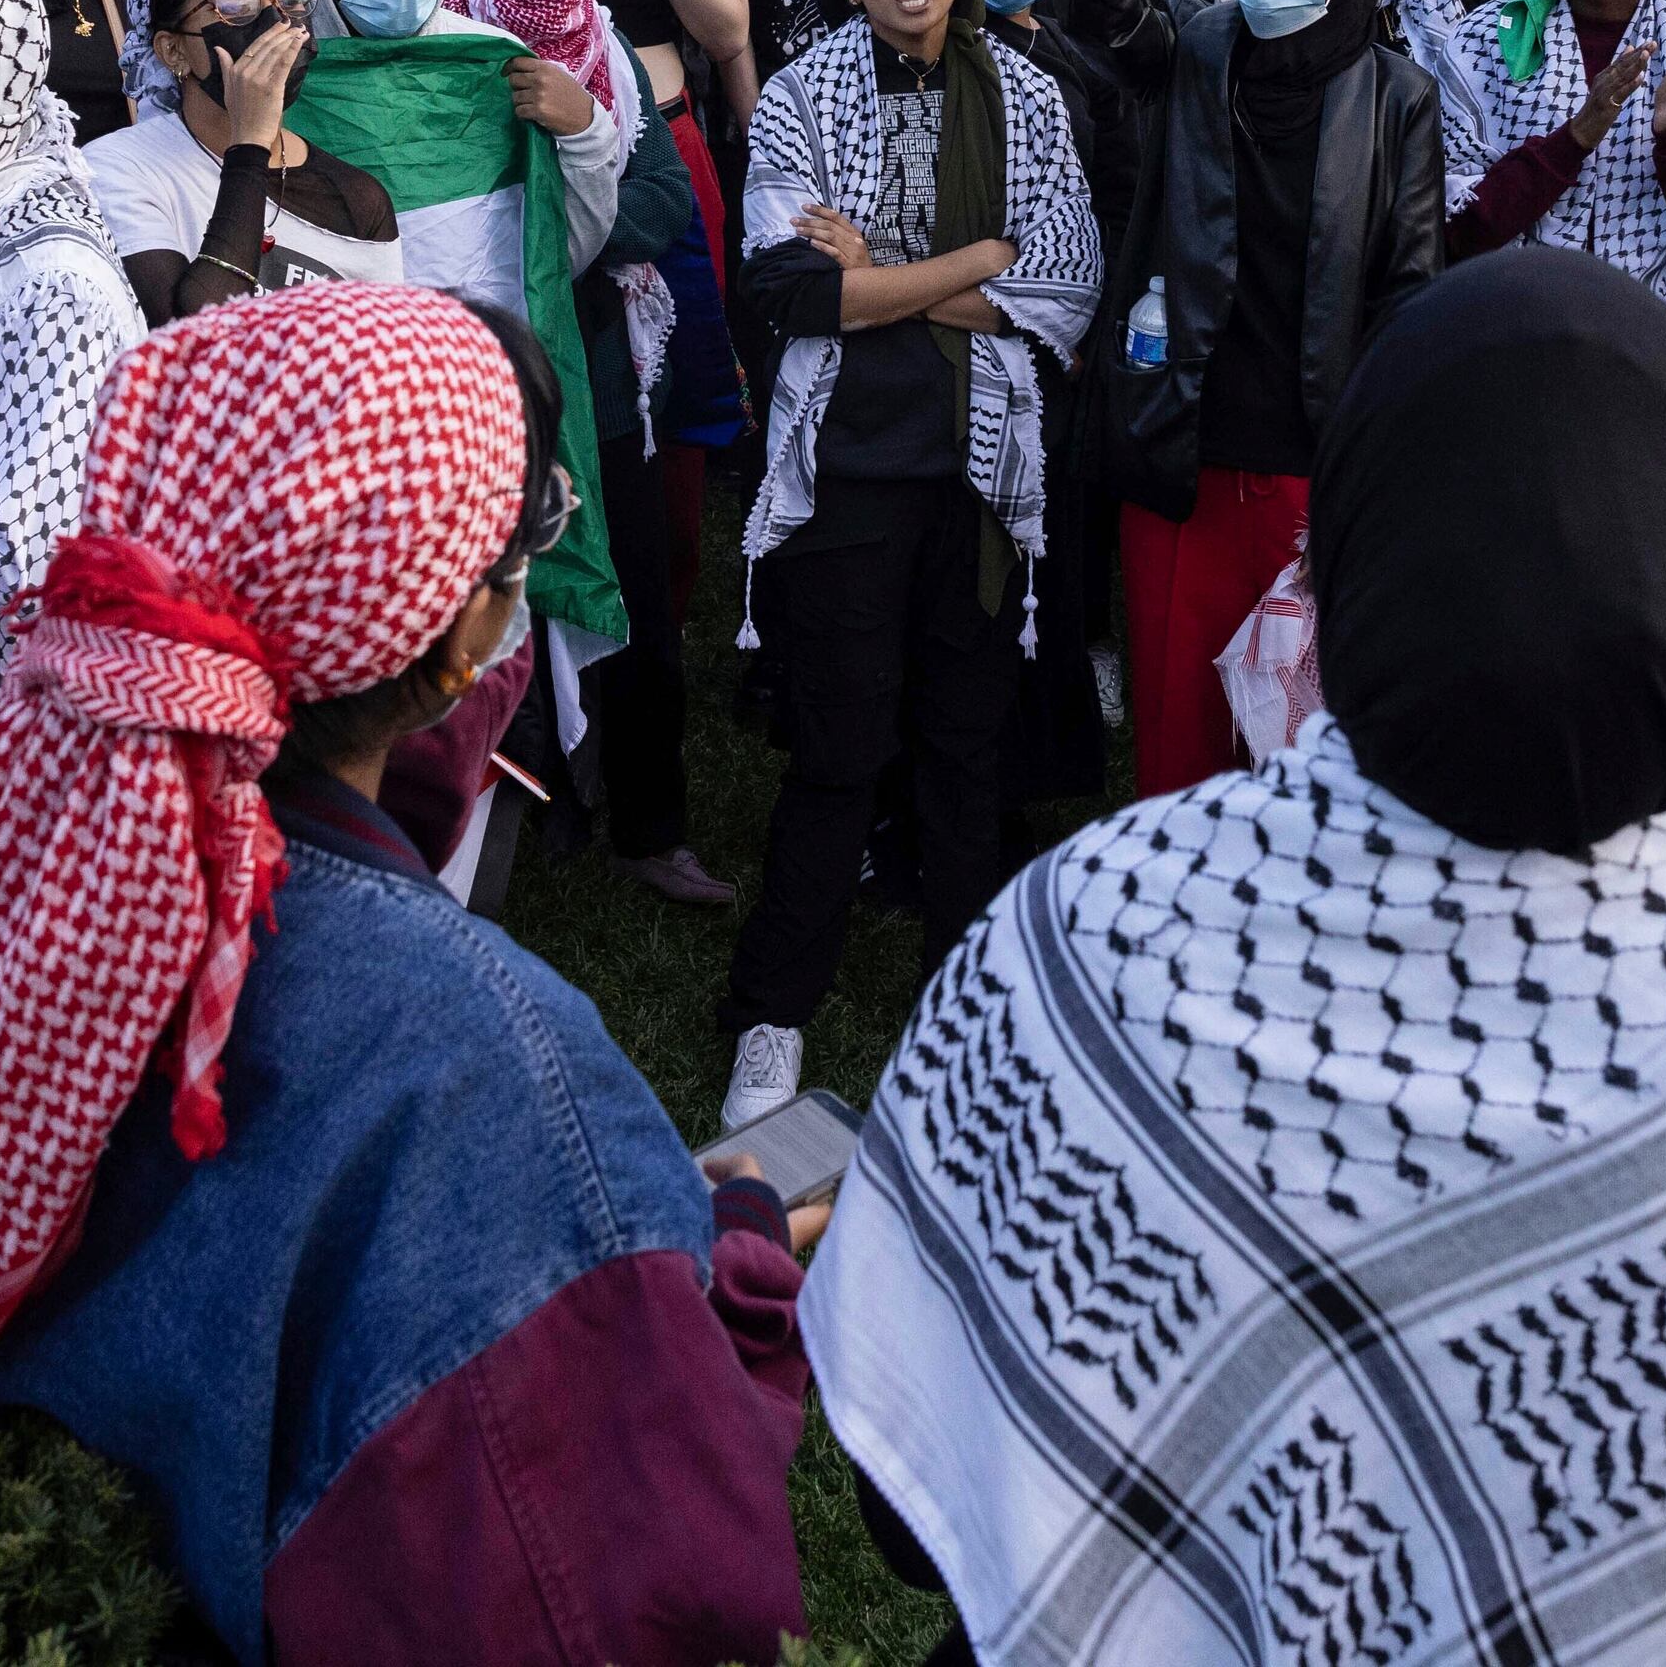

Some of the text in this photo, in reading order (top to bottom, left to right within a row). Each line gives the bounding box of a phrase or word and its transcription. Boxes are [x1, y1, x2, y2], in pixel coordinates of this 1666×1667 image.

[901, 153, 933, 163] SOMALIA
[904, 168, 933, 177] BRUNEI
[905, 177, 935, 186] BAHRAIN
[904, 187, 936, 196] MALAYSIA
[903, 196, 936, 204] PALESTIN
[871, 214, 898, 228] GYPT
